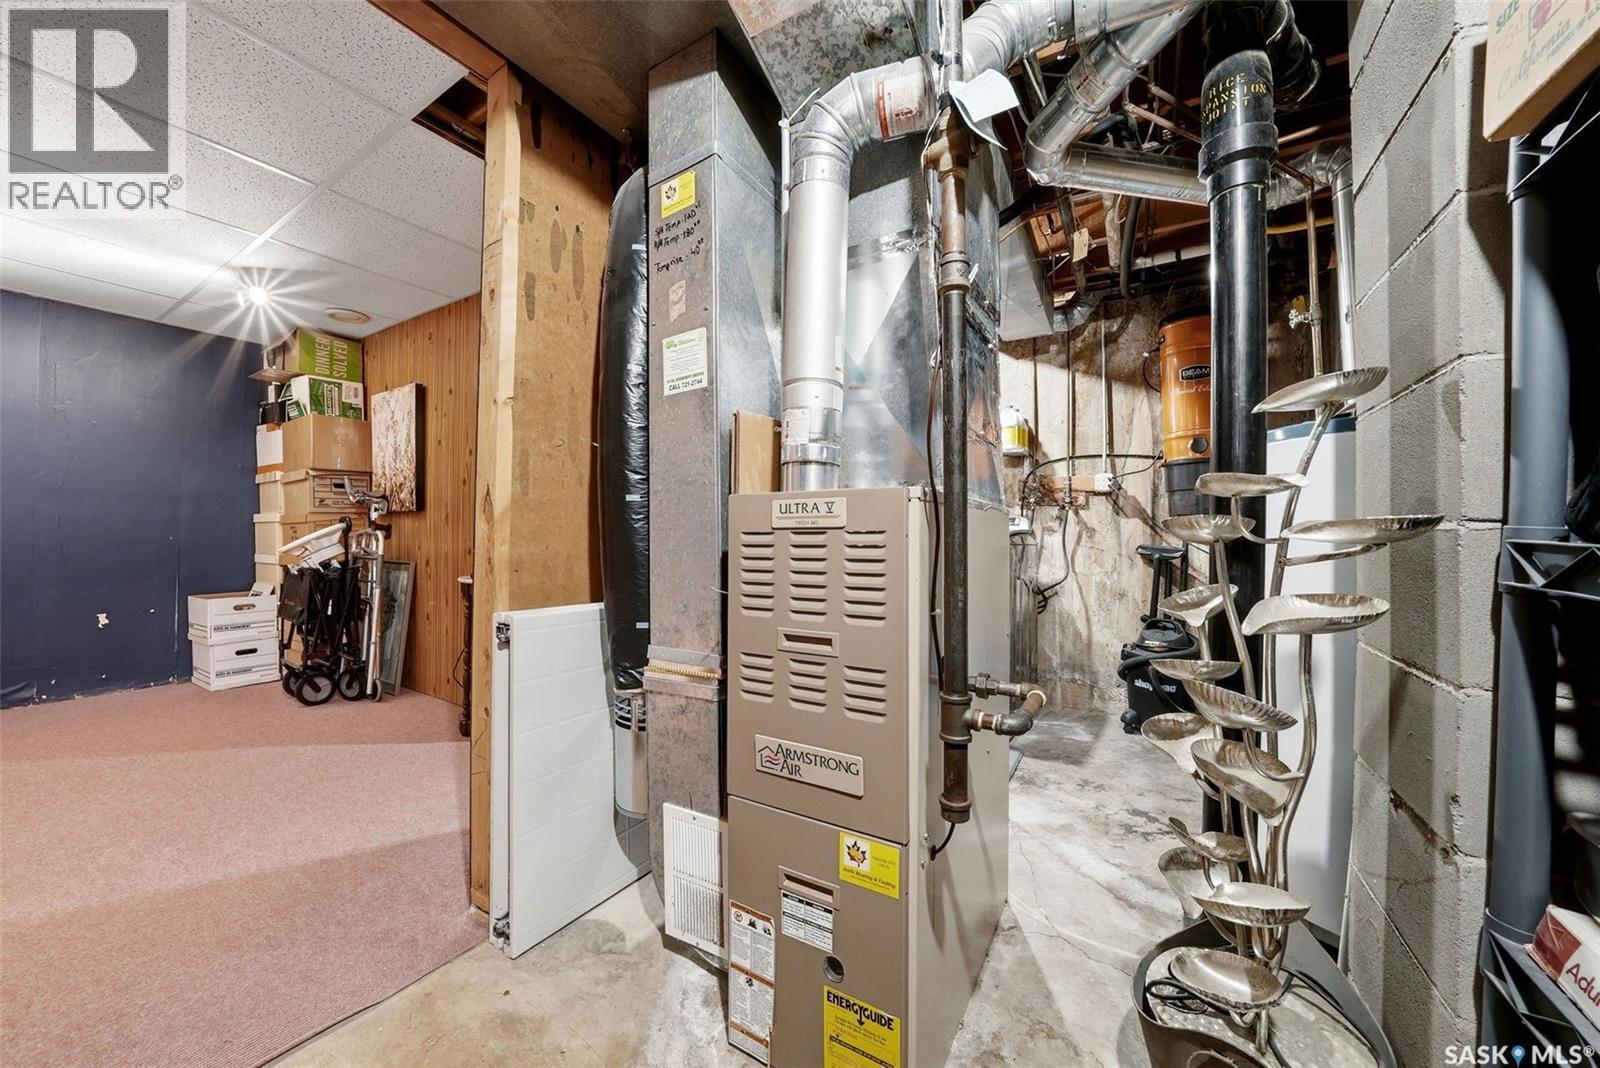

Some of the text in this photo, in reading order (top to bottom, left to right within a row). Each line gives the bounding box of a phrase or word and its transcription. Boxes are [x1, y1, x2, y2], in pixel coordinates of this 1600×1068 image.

[1206, 96, 1250, 125] JOINT
[315, 336, 330, 375] DINNER
[332, 340, 348, 378] SOLVED
[1182, 367, 1210, 378] BEAM
[779, 501, 835, 515] ULTRA V
[775, 743, 859, 776] ARMSTRONG
[780, 759, 802, 777] AIR
[1566, 963, 1600, 1008] Adu
[826, 990, 894, 1032] ENERGYGUIDE
